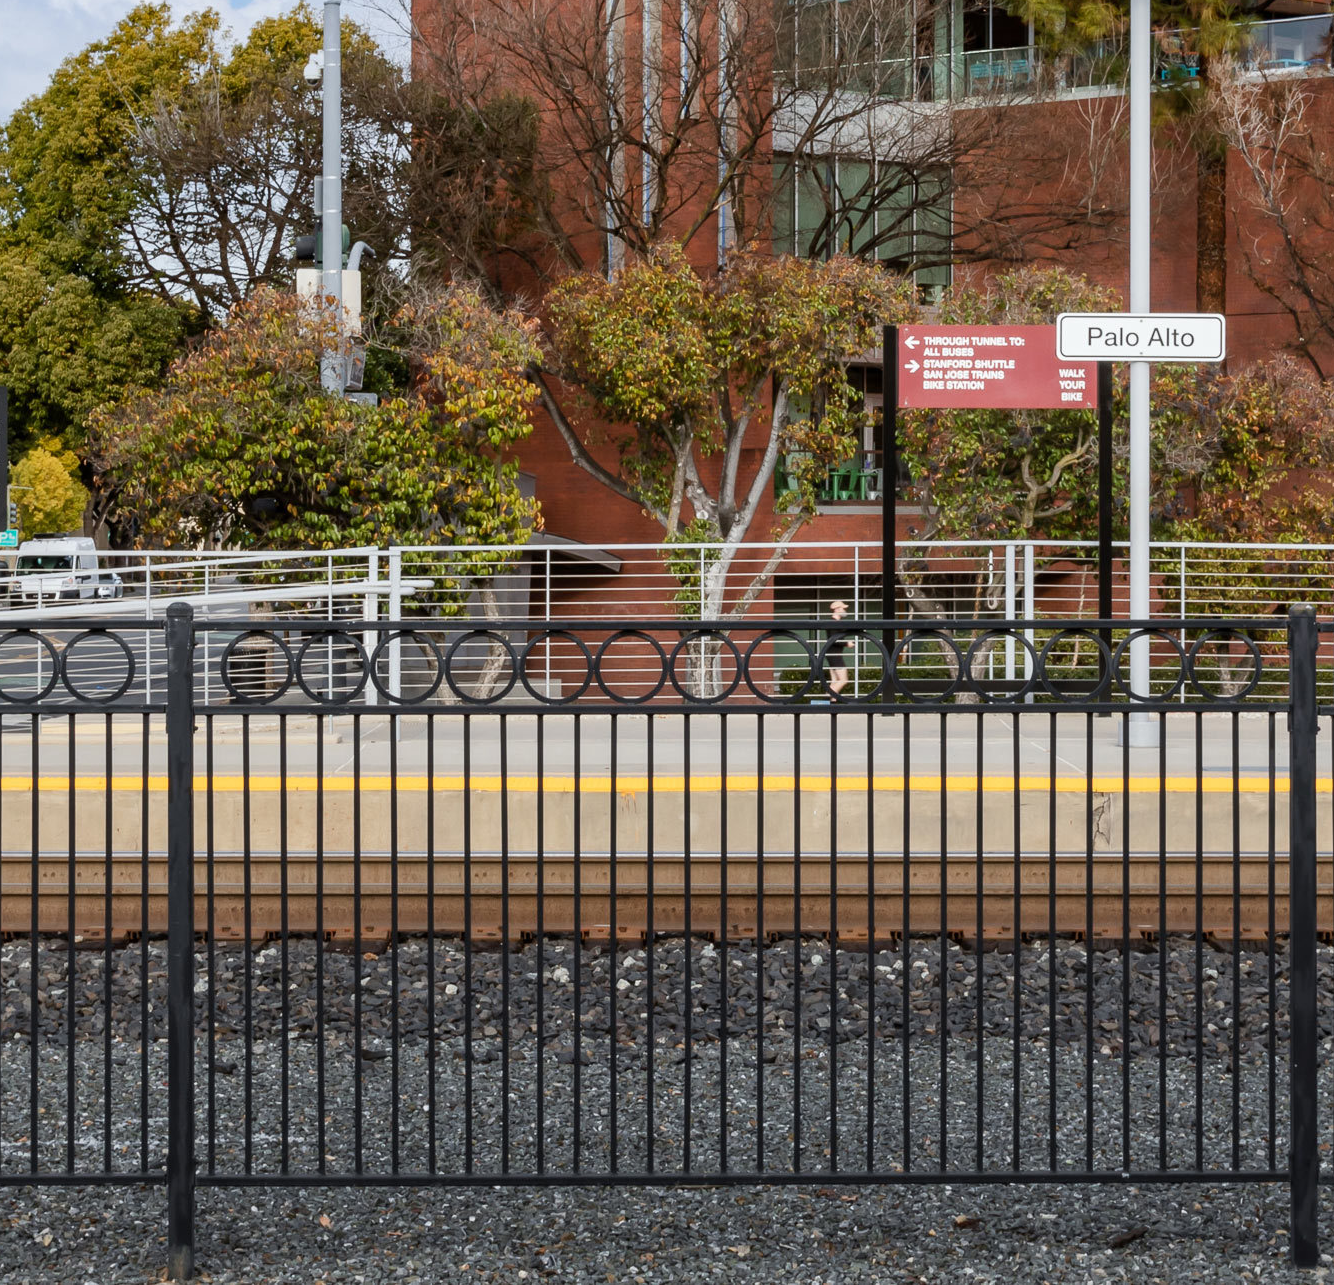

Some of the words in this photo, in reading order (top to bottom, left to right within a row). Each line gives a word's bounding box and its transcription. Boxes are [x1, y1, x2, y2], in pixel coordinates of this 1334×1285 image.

[923, 336, 970, 346] THROUGH
[970, 336, 1008, 346] TUNNEL
[1008, 336, 1026, 346] TO:
[1088, 327, 1140, 347] Palo
[1147, 327, 1195, 347] Alto
[923, 347, 941, 357] ALL
[942, 347, 975, 357] BUSES
[923, 359, 973, 369] STANFORD
[974, 359, 1016, 369] SHUTTLE
[923, 370, 943, 380] SAN
[944, 370, 970, 380] JOSE
[971, 370, 1005, 380] TRAINS
[1058, 368, 1086, 378] WALK
[923, 380, 945, 390] BIKE
[946, 380, 985, 390] STATION
[1058, 380, 1086, 390] YOUR
[1060, 392, 1083, 402] BIKE
